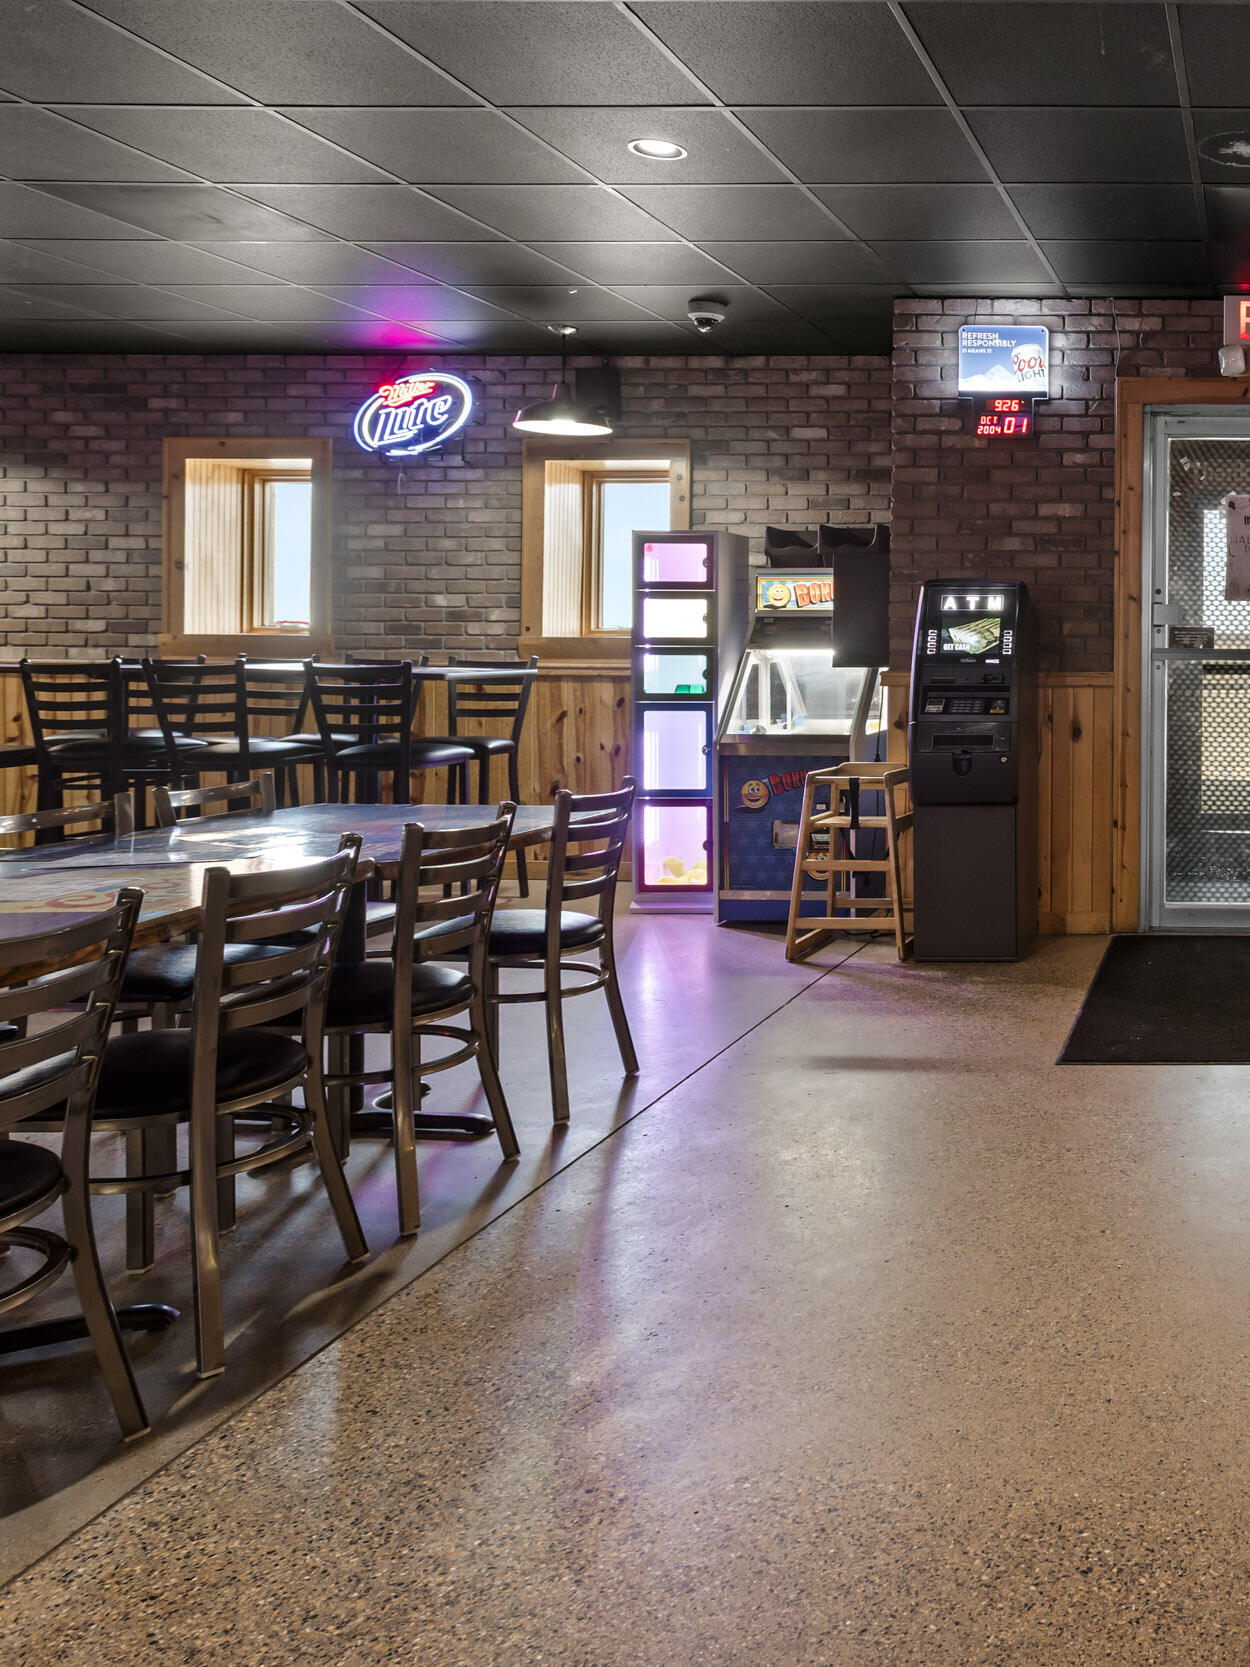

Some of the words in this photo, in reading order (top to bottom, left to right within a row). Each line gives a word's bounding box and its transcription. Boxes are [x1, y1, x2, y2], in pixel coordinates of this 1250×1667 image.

[962, 332, 999, 340] REFRESH
[962, 340, 1017, 348] RESPONSIBLY
[1012, 354, 1046, 375] Coor
[379, 382, 436, 403] Miller
[977, 425, 1002, 435] 2004
[1003, 417, 1028, 434] 01
[980, 416, 999, 425] OCT
[943, 596, 1003, 611] ATM
